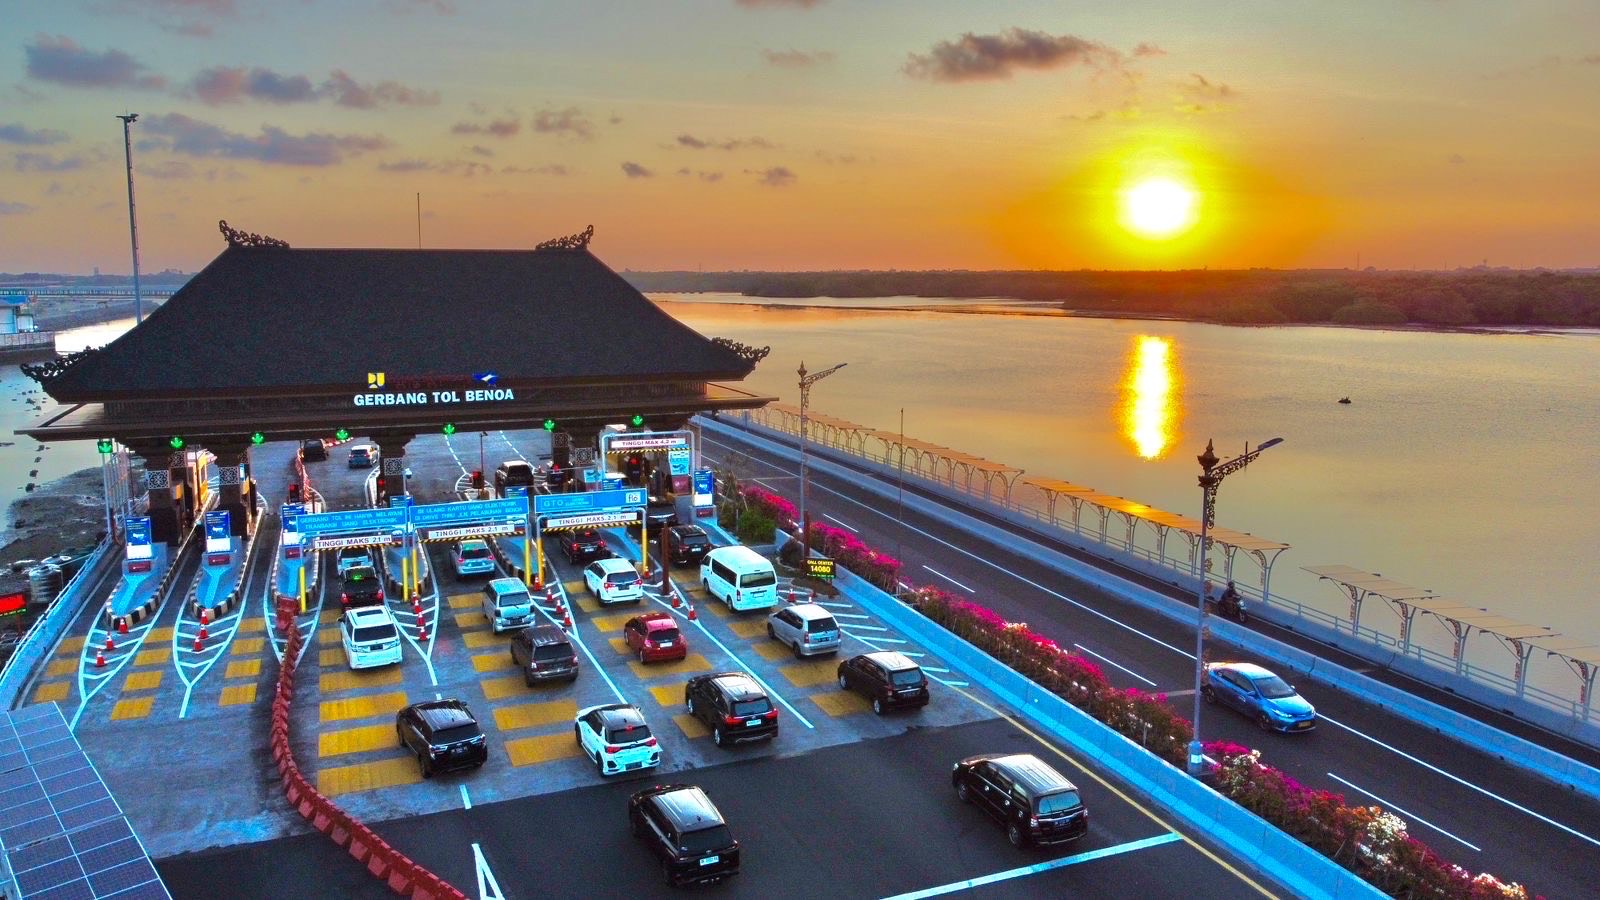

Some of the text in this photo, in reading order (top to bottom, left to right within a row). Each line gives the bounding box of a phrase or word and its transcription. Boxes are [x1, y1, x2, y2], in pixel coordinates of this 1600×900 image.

[354, 388, 514, 406] GERBANG TOL BENOA
[628, 494, 638, 502] flo
